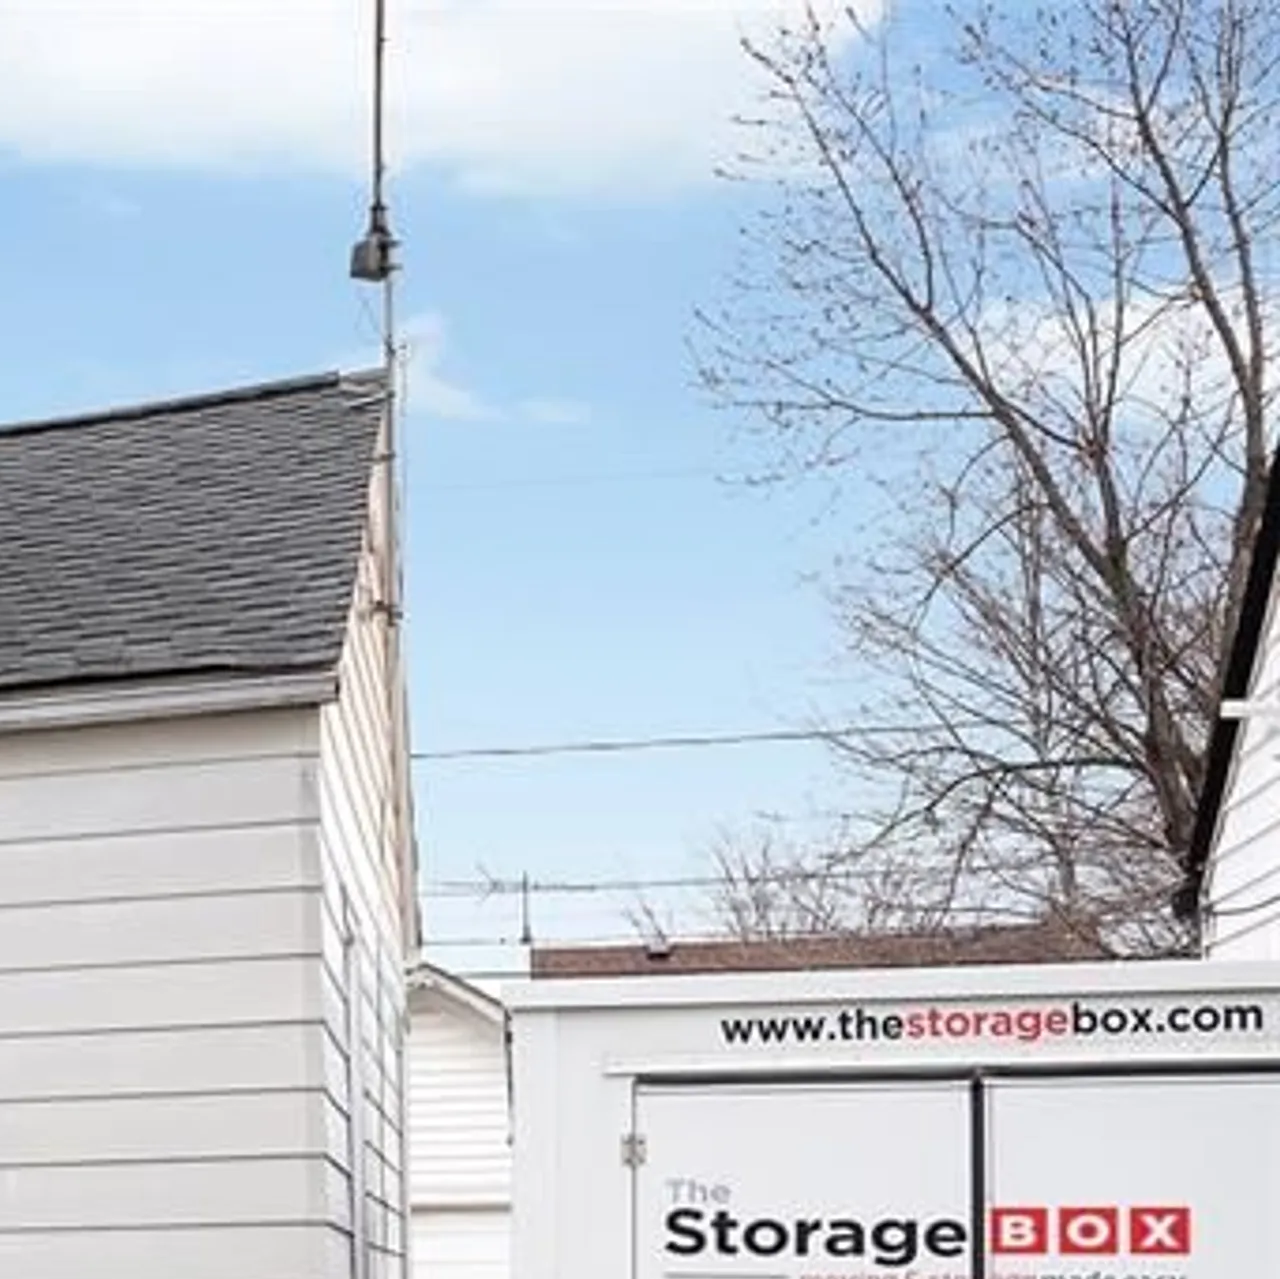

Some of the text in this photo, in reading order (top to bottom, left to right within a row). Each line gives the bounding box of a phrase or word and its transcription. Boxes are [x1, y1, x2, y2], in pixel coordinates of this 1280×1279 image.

[721, 1001, 1264, 1043] www.thestoragebox.com
[666, 1179, 732, 1204] The
[664, 1207, 1182, 1267] Storage BOX
